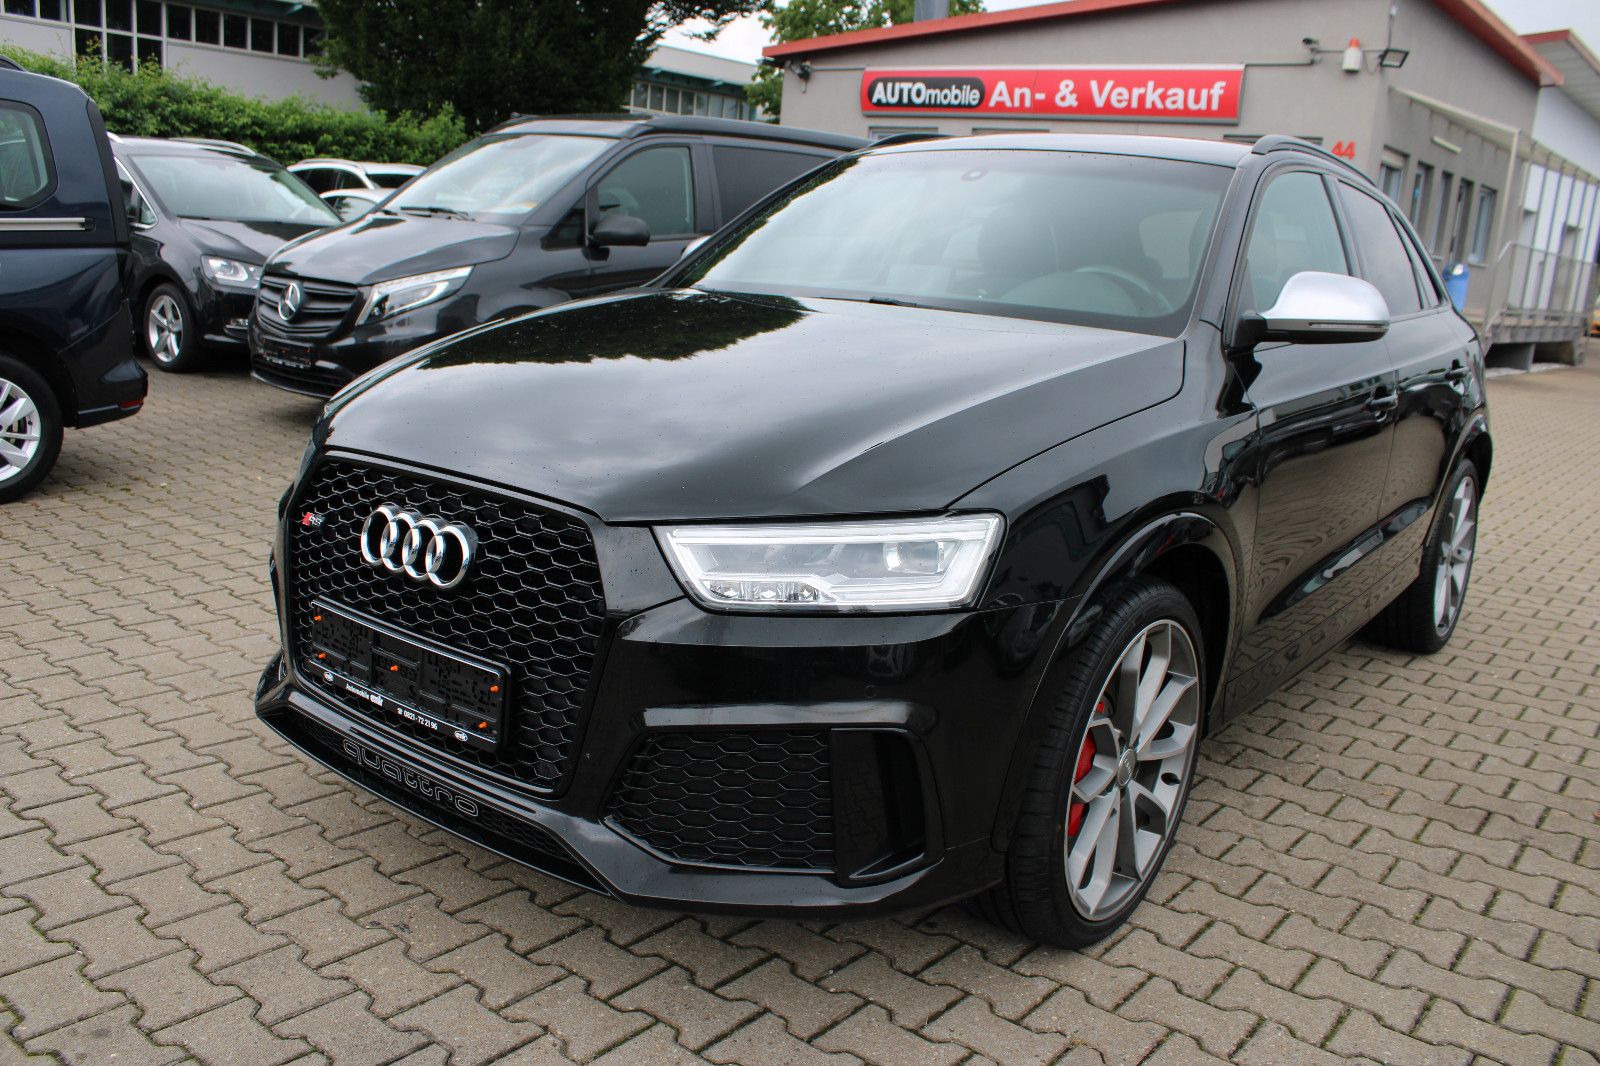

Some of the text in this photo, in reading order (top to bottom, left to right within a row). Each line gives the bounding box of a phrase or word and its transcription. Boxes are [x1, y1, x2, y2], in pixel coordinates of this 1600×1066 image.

[871, 79, 1227, 112] AUTOmobile An- & Verkauf
[1331, 140, 1355, 160] 44
[343, 738, 479, 817] quattro
